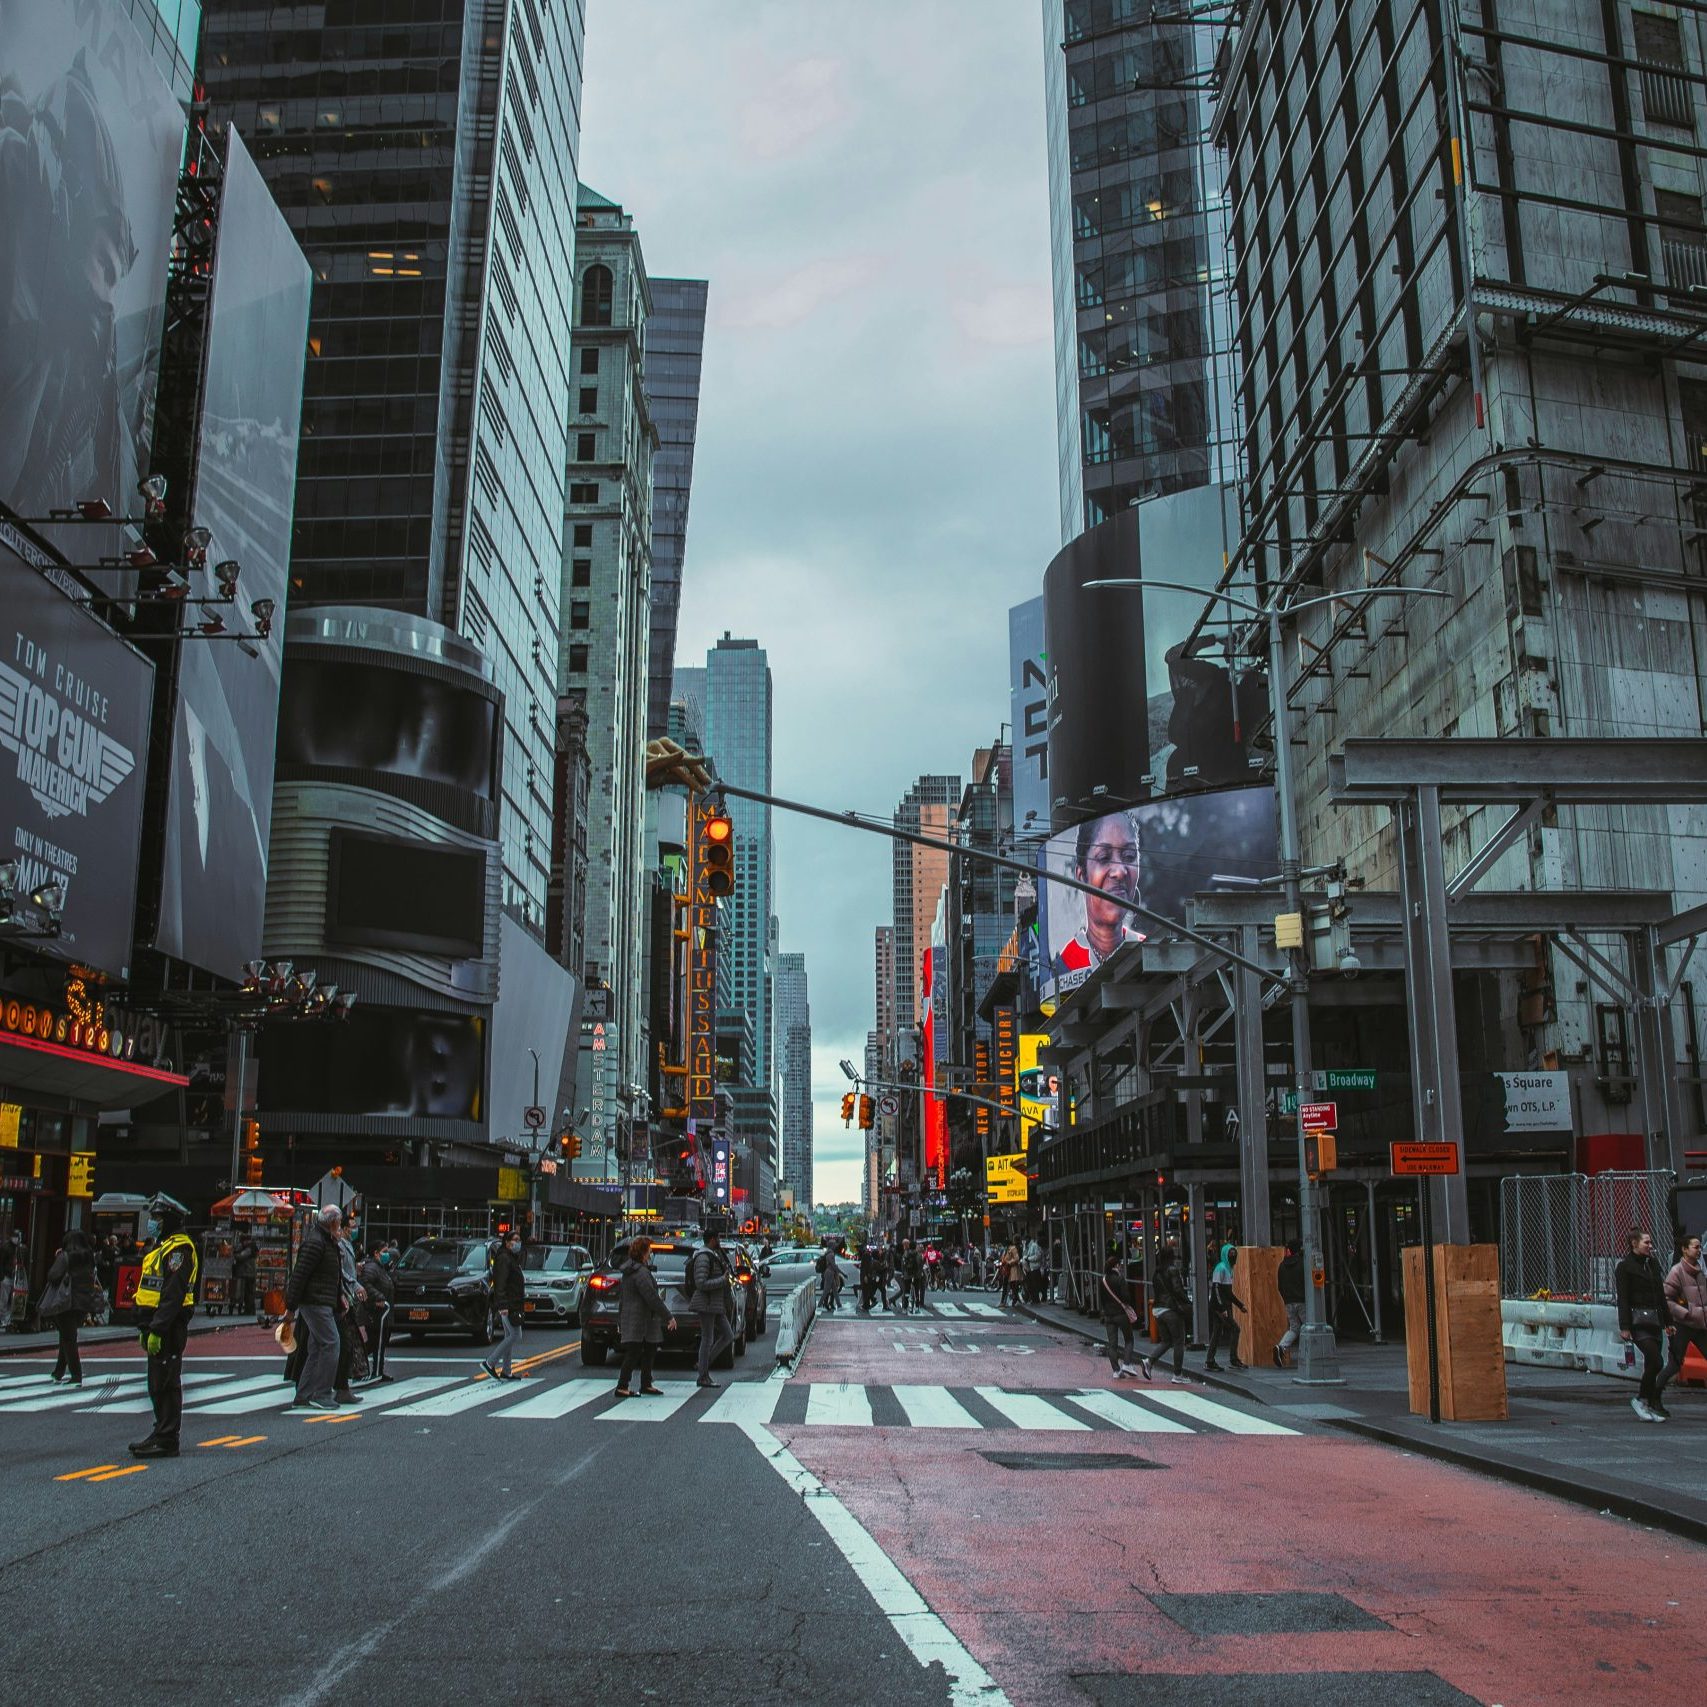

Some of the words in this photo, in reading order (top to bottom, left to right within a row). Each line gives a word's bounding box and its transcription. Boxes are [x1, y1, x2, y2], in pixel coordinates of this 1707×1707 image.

[15, 631, 47, 680] TOM
[55, 663, 109, 725] CRUISE
[13, 679, 60, 756] TOP
[57, 707, 104, 789] GUN
[16, 744, 92, 817] MAVERICK
[15, 826, 35, 851] ONLY
[35, 836, 43, 858] IN
[44, 840, 78, 875] THEATRES
[18, 854, 50, 896] MAY
[1059, 972, 1084, 989] CHASE
[695, 950, 713, 1117] TUSSAUDS
[998, 1008, 1013, 1076] VICTORY
[975, 1043, 989, 1084] CTORY
[1330, 1073, 1375, 1089] Broadway
[591, 1022, 606, 1158] AMSTERDAM
[999, 1085, 1014, 1117] NEW
[1513, 1076, 1553, 1091] Square
[976, 1107, 989, 1135] NEW
[1309, 1104, 1331, 1112] STANDING
[1520, 1102, 1540, 1113] OTS,
[1542, 1101, 1556, 1112] L.P.
[1400, 1145, 1427, 1153] SIDEWALK
[892, 1342, 1036, 1355] BUS
